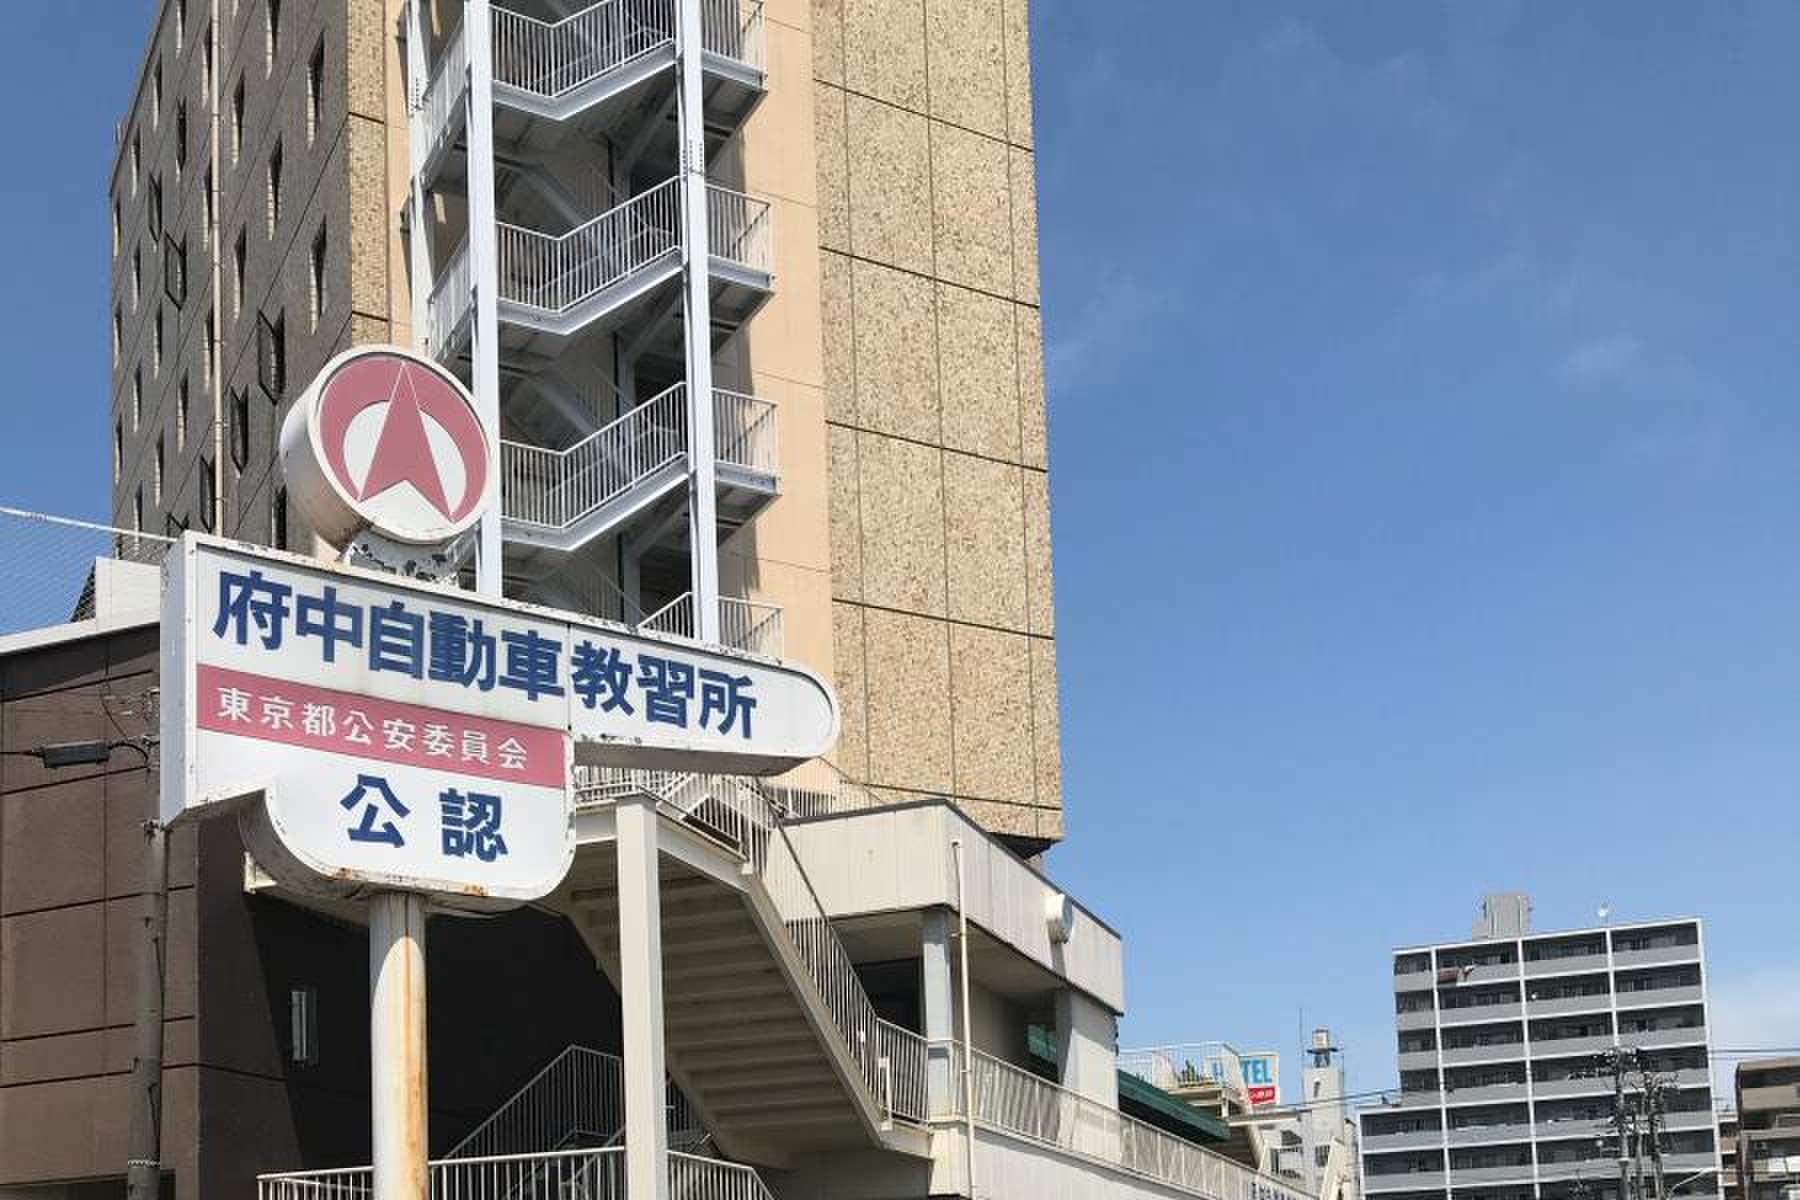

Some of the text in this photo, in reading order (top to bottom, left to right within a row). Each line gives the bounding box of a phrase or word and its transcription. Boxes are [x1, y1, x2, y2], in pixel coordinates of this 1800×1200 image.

[213, 571, 757, 738] 府中自動車教習所
[217, 687, 528, 769] 東京都公安委員会
[340, 774, 508, 862] 公認
